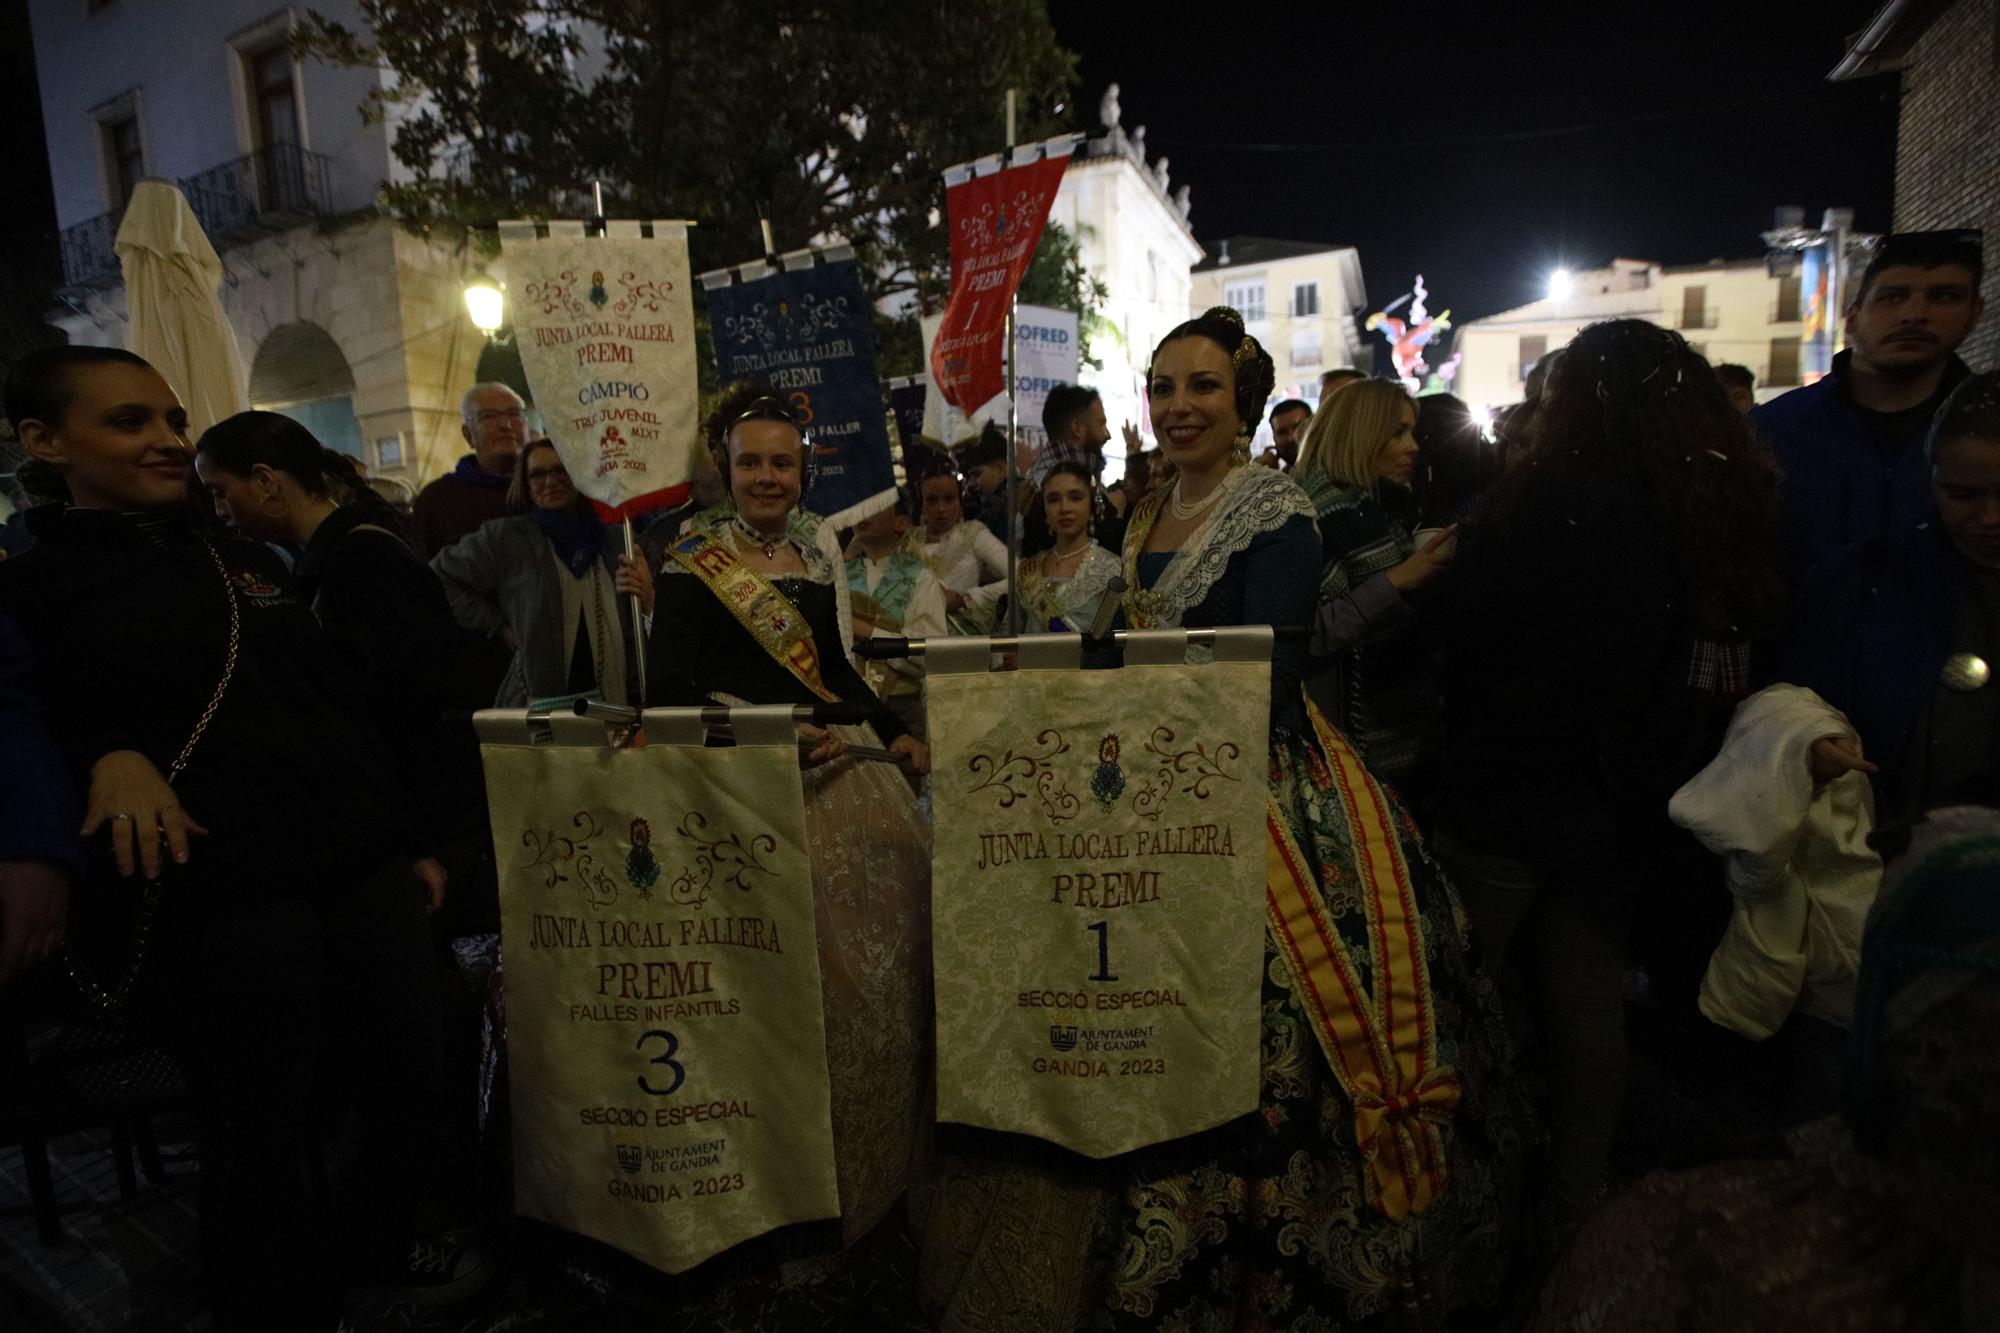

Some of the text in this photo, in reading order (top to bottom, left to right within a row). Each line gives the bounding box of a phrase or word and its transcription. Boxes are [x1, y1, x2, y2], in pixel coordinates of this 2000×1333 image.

[967, 268, 1008, 292] PREMI
[963, 299, 980, 331] 1
[536, 321, 675, 348] JUNTA LOCAL FALLERA
[577, 341, 634, 366] PREMI
[733, 339, 855, 373] JUNTA LOCAL FALLERA
[769, 367, 823, 388] PREMI
[578, 381, 649, 405] CAMPIÓ
[600, 408, 662, 425] JUVENIL
[789, 391, 815, 426] 3
[631, 426, 660, 440] MIXT
[819, 421, 861, 437] FALLER
[623, 459, 647, 472] 2023
[978, 822, 1236, 870] JUNTA LOCAL FALLERA
[1051, 871, 1161, 909] PREMI
[529, 912, 783, 955] JUNTA LOCAL FALLERA
[1086, 921, 1119, 982] 1
[597, 961, 713, 1001] PREMI
[570, 999, 740, 1022] FALLES INFANTILS
[1017, 989, 1187, 1010] SECCIÓ ESPECIAL
[1080, 1026, 1154, 1042] AJUNTAMENT
[1086, 1040, 1147, 1051] DE GANDIA
[636, 1030, 686, 1095] 3
[1032, 1058, 1165, 1078] GANDIA 2023
[655, 1100, 756, 1128] ESPECIAL
[644, 1139, 726, 1161] AJUNTAMENT
[651, 1153, 721, 1173] DE GANDIA
[608, 1172, 745, 1203] GANDIA 2023
